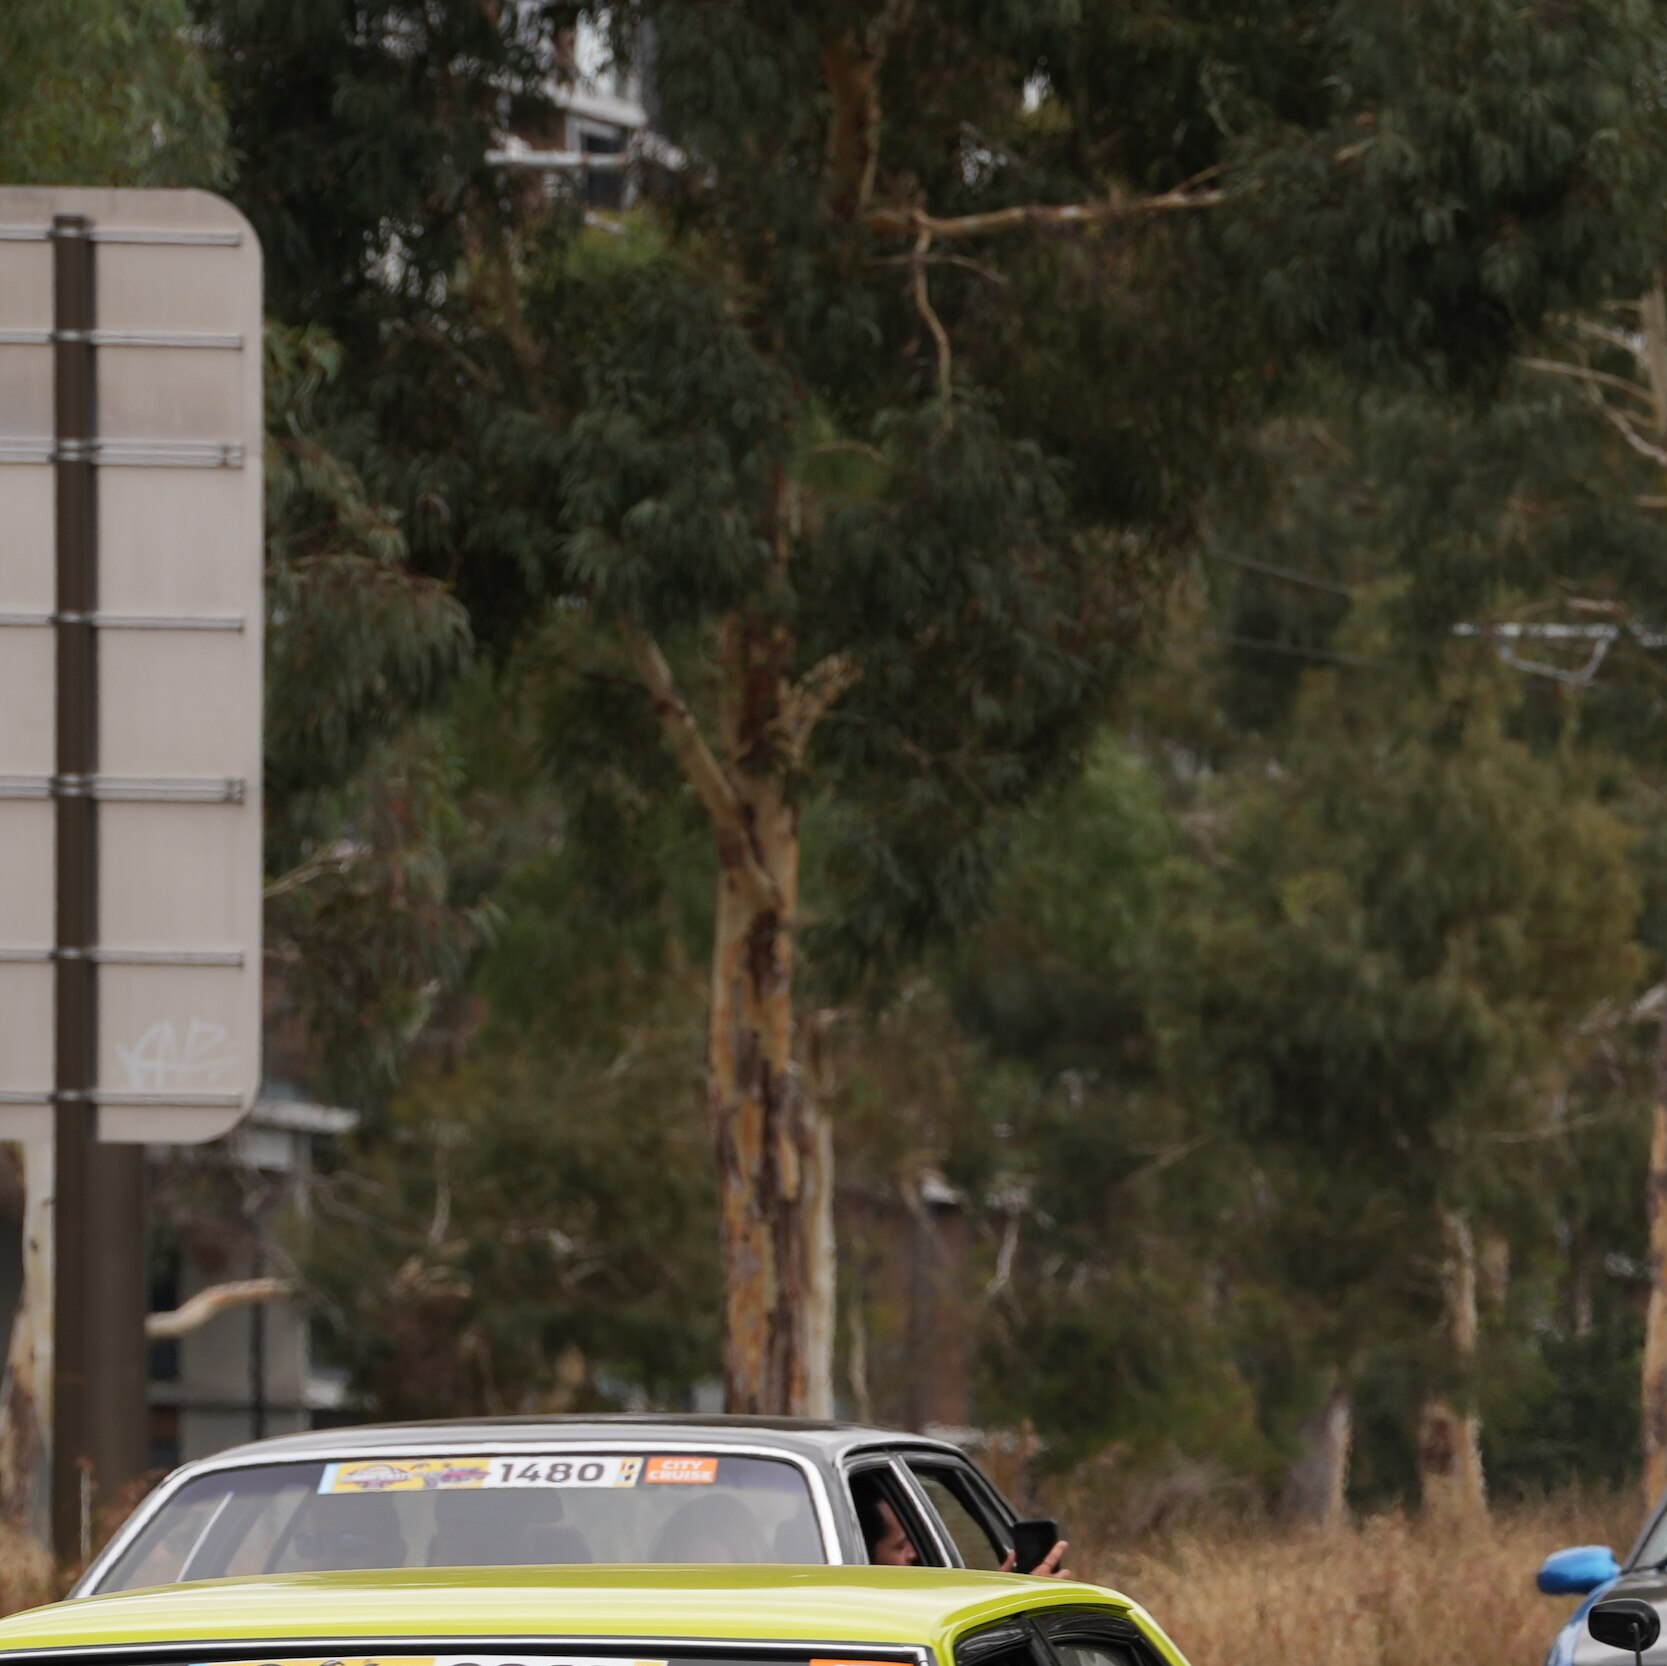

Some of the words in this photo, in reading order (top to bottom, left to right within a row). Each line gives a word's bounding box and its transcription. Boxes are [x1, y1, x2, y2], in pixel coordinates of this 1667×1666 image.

[661, 1460, 704, 1470] CITY
[501, 1463, 605, 1483] 1480
[649, 1470, 713, 1481] CRUISE
